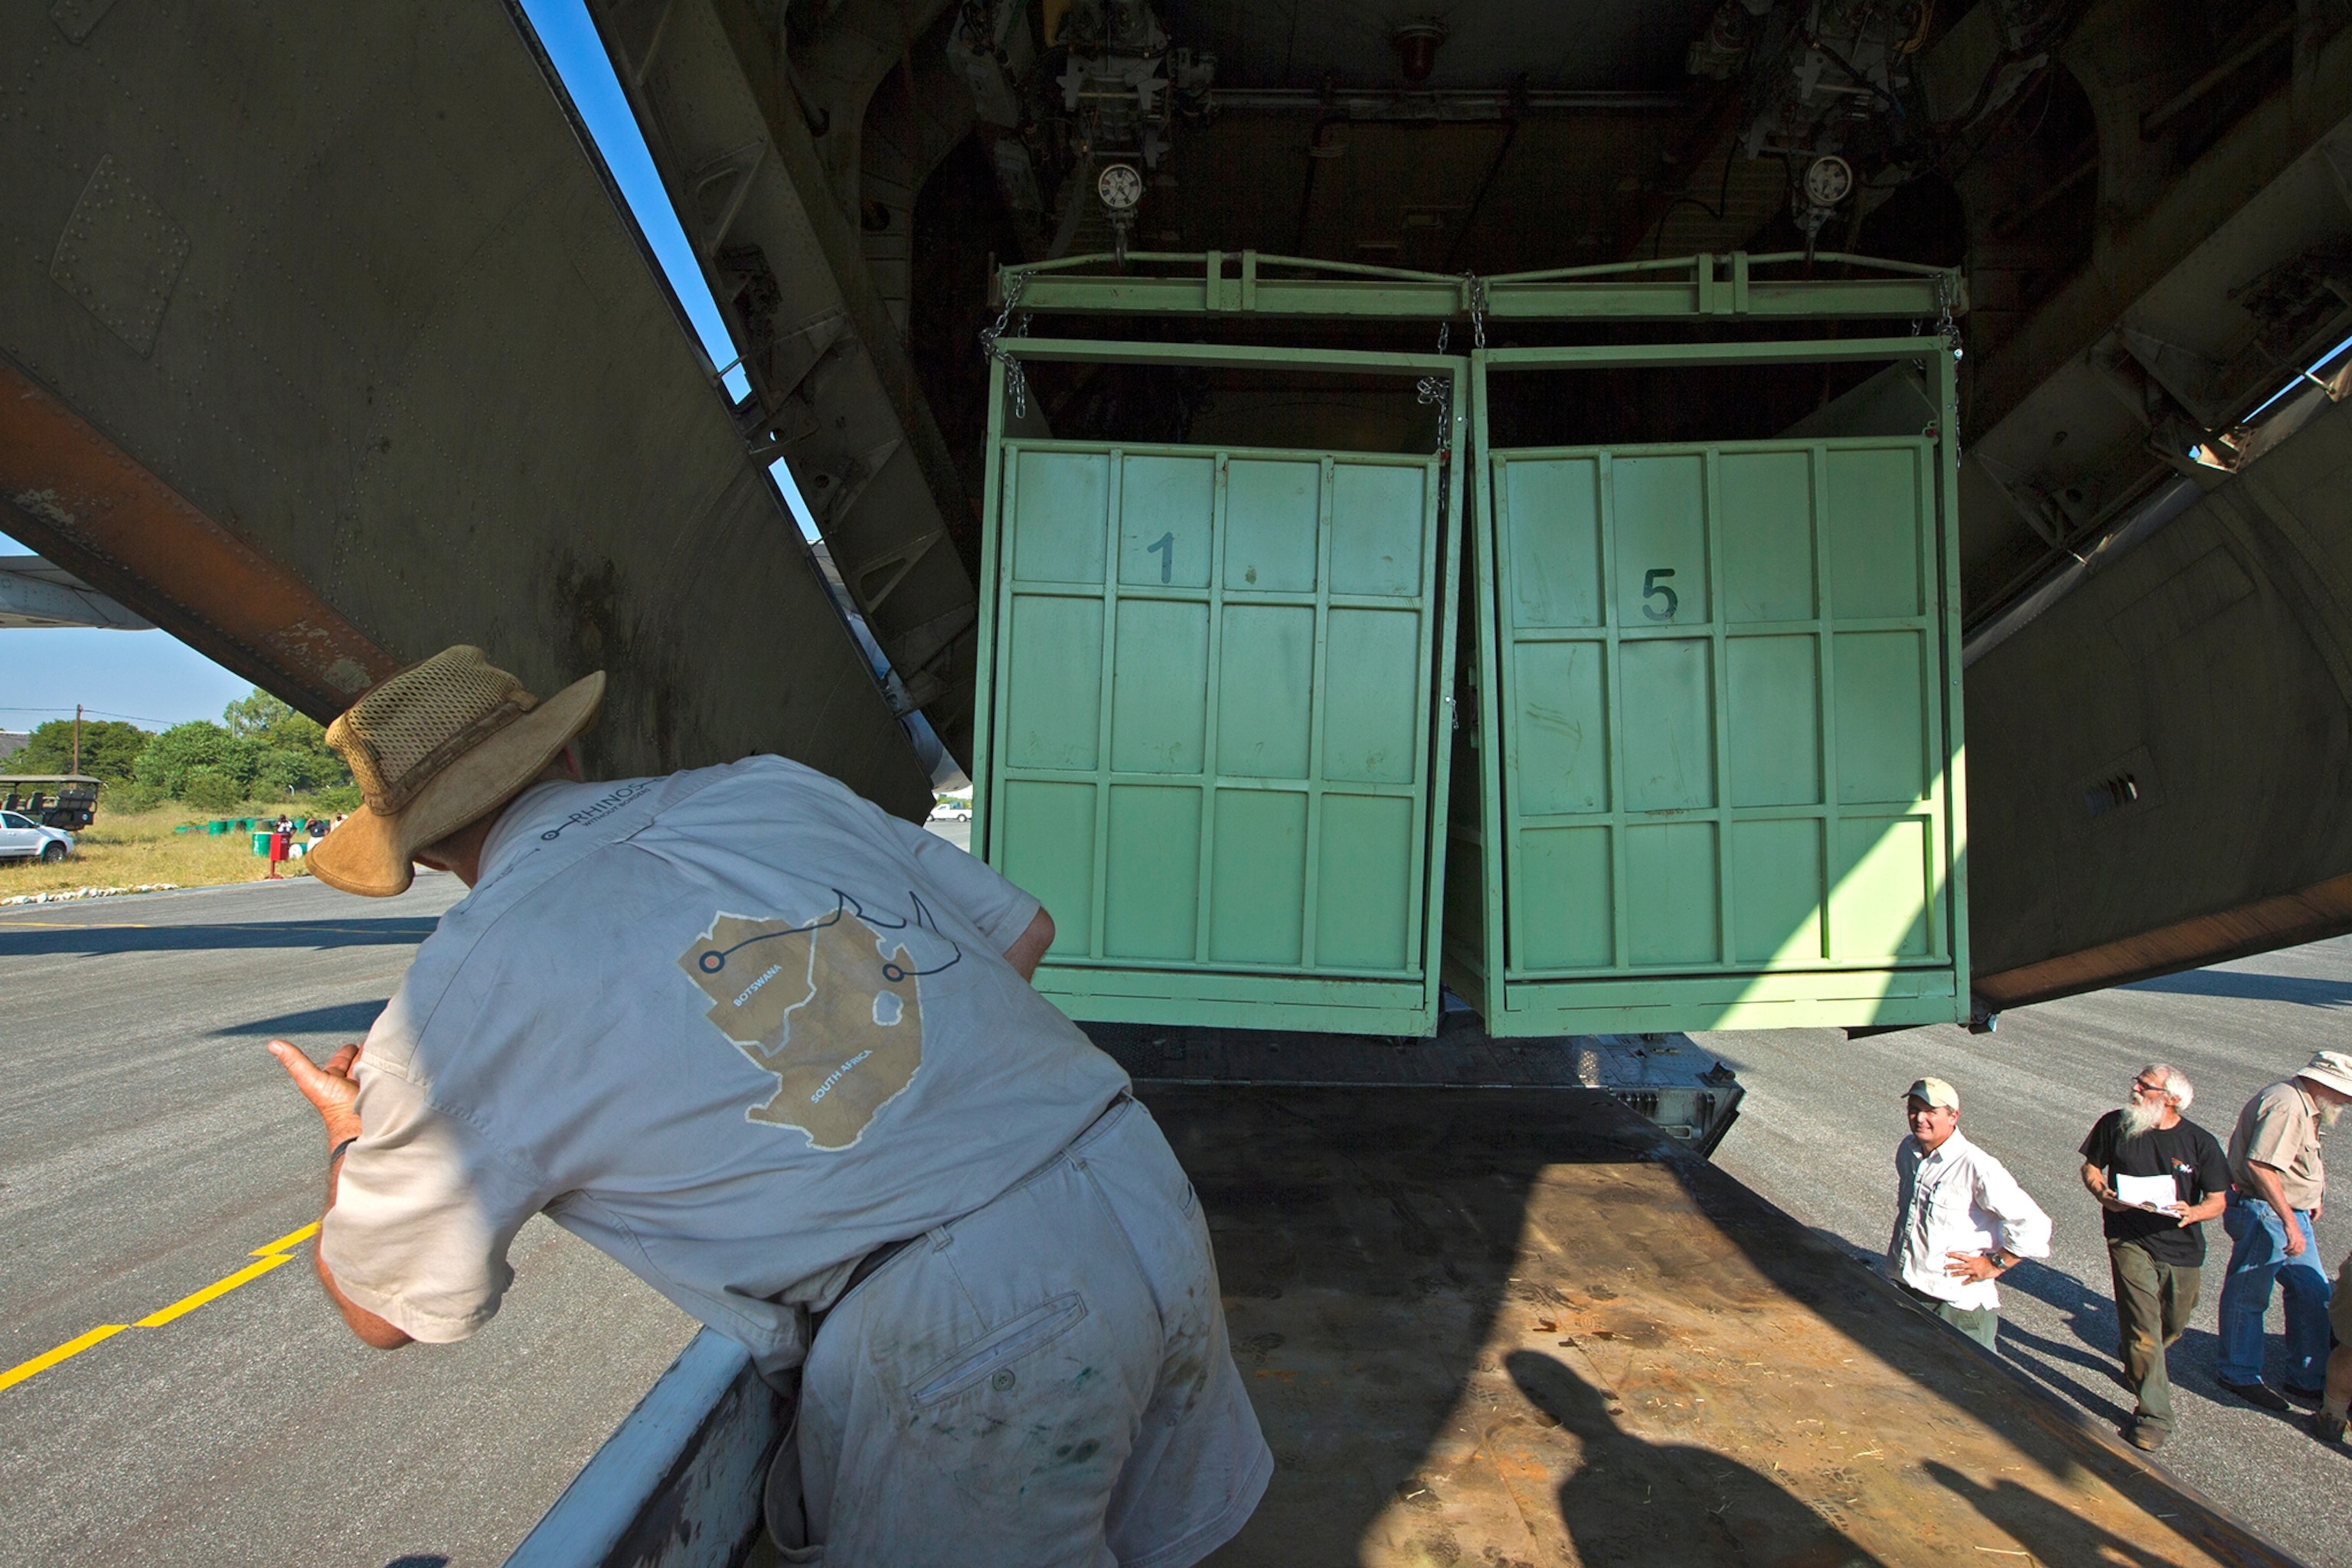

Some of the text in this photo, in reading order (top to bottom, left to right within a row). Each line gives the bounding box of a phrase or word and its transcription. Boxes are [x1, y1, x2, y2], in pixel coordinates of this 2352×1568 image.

[1147, 531, 1173, 584] 1
[1642, 568, 1678, 621] 5
[568, 782, 642, 824] RHINOS
[582, 788, 652, 828] WITHOUT BORDERS
[733, 963, 782, 1008] BOTSWANA
[810, 1050, 874, 1104] SOUTH AFRICA
